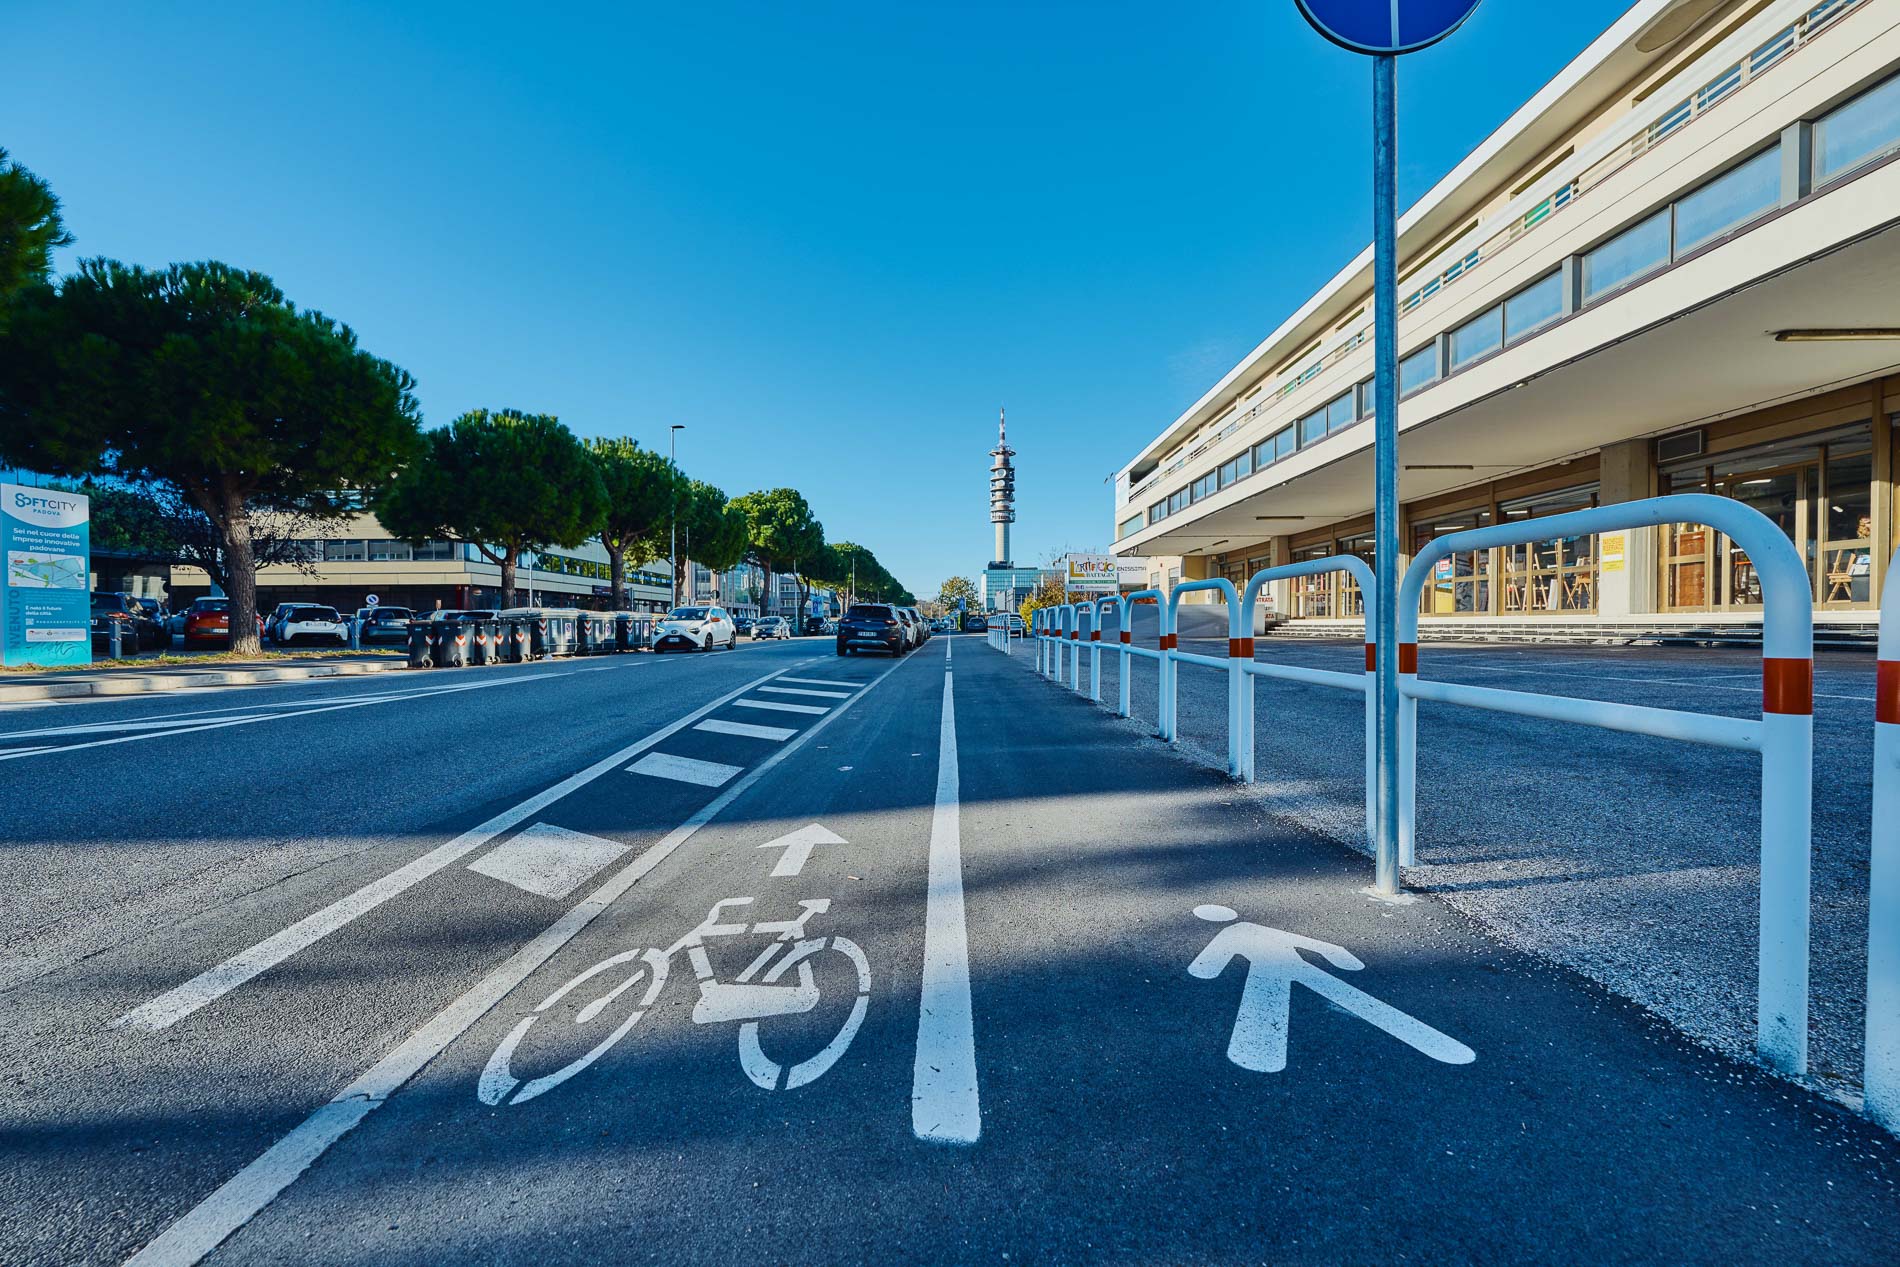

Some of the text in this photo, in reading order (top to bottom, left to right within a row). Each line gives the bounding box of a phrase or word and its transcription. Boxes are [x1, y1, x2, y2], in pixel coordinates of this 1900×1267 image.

[15, 492, 77, 511] SOFTCITY
[33, 508, 61, 516] PADOVA
[12, 535, 80, 547] imprese innovative
[30, 545, 65, 553] padovane
